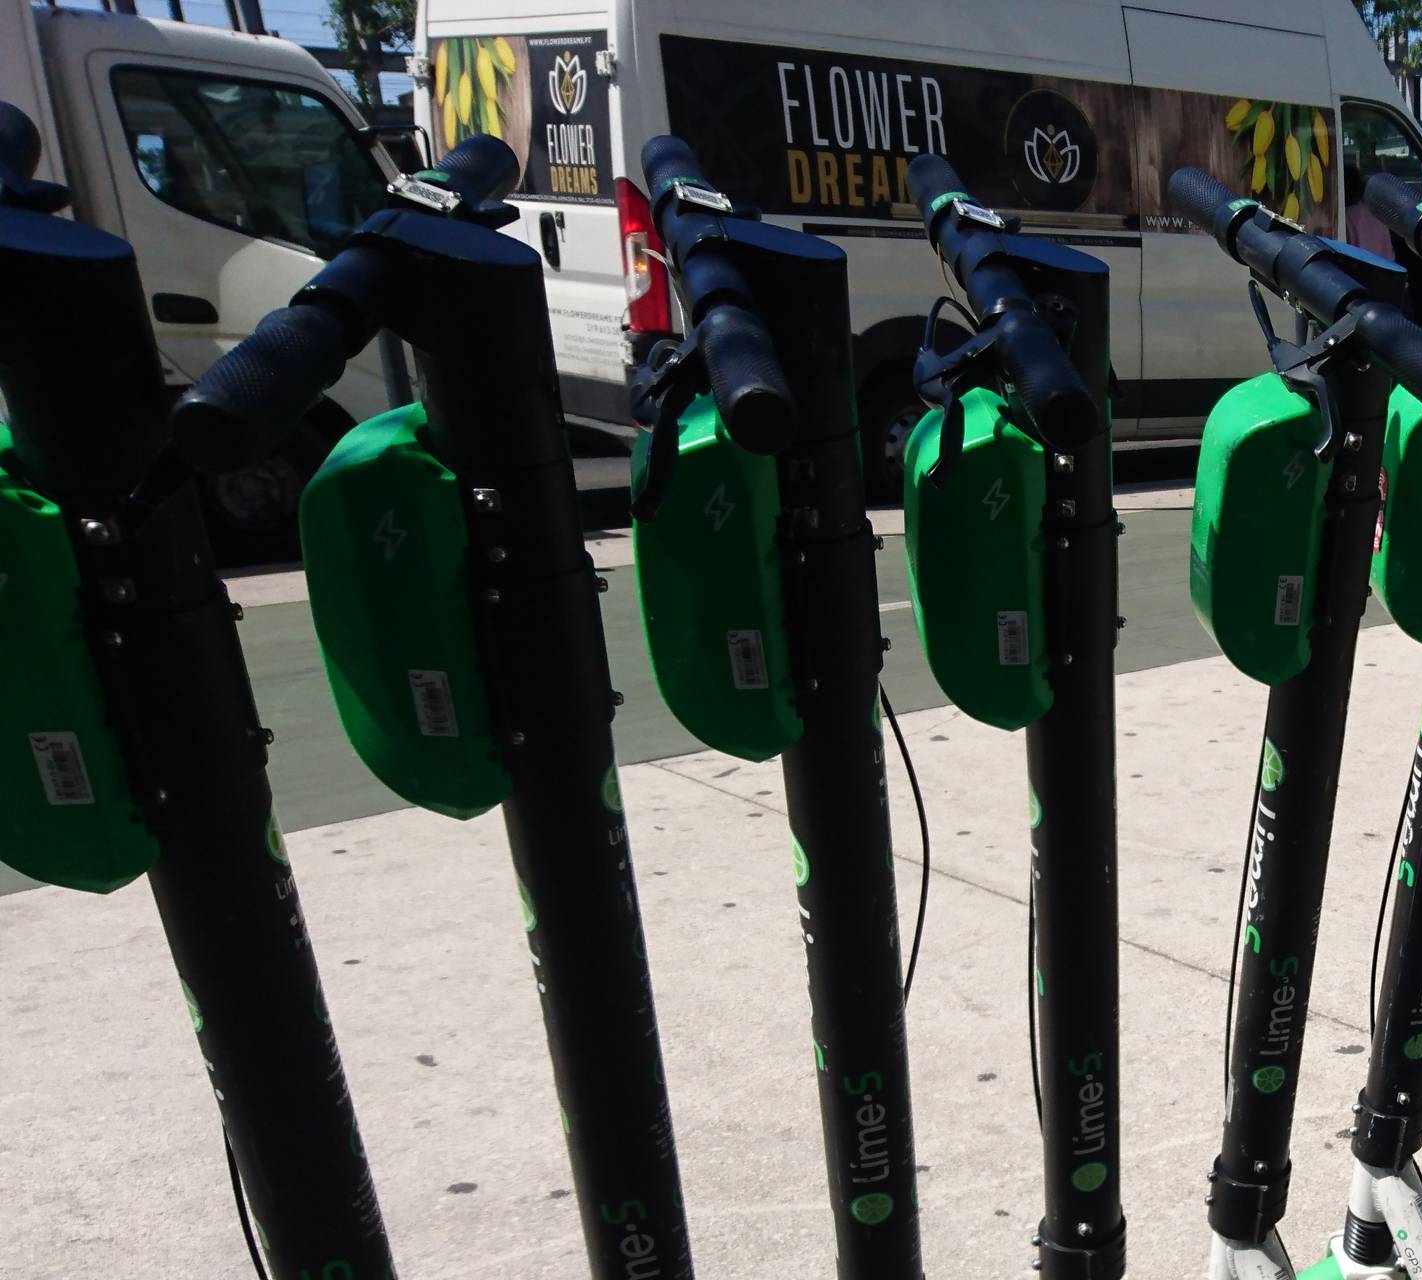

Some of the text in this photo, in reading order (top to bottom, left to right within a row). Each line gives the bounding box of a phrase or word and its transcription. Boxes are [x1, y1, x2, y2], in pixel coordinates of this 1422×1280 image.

[777, 61, 948, 155] FLOWER
[546, 123, 596, 165] FLOWER
[550, 165, 599, 195] DREAMS
[786, 149, 914, 208] DREA
[1405, 1246, 1422, 1274] GPS
